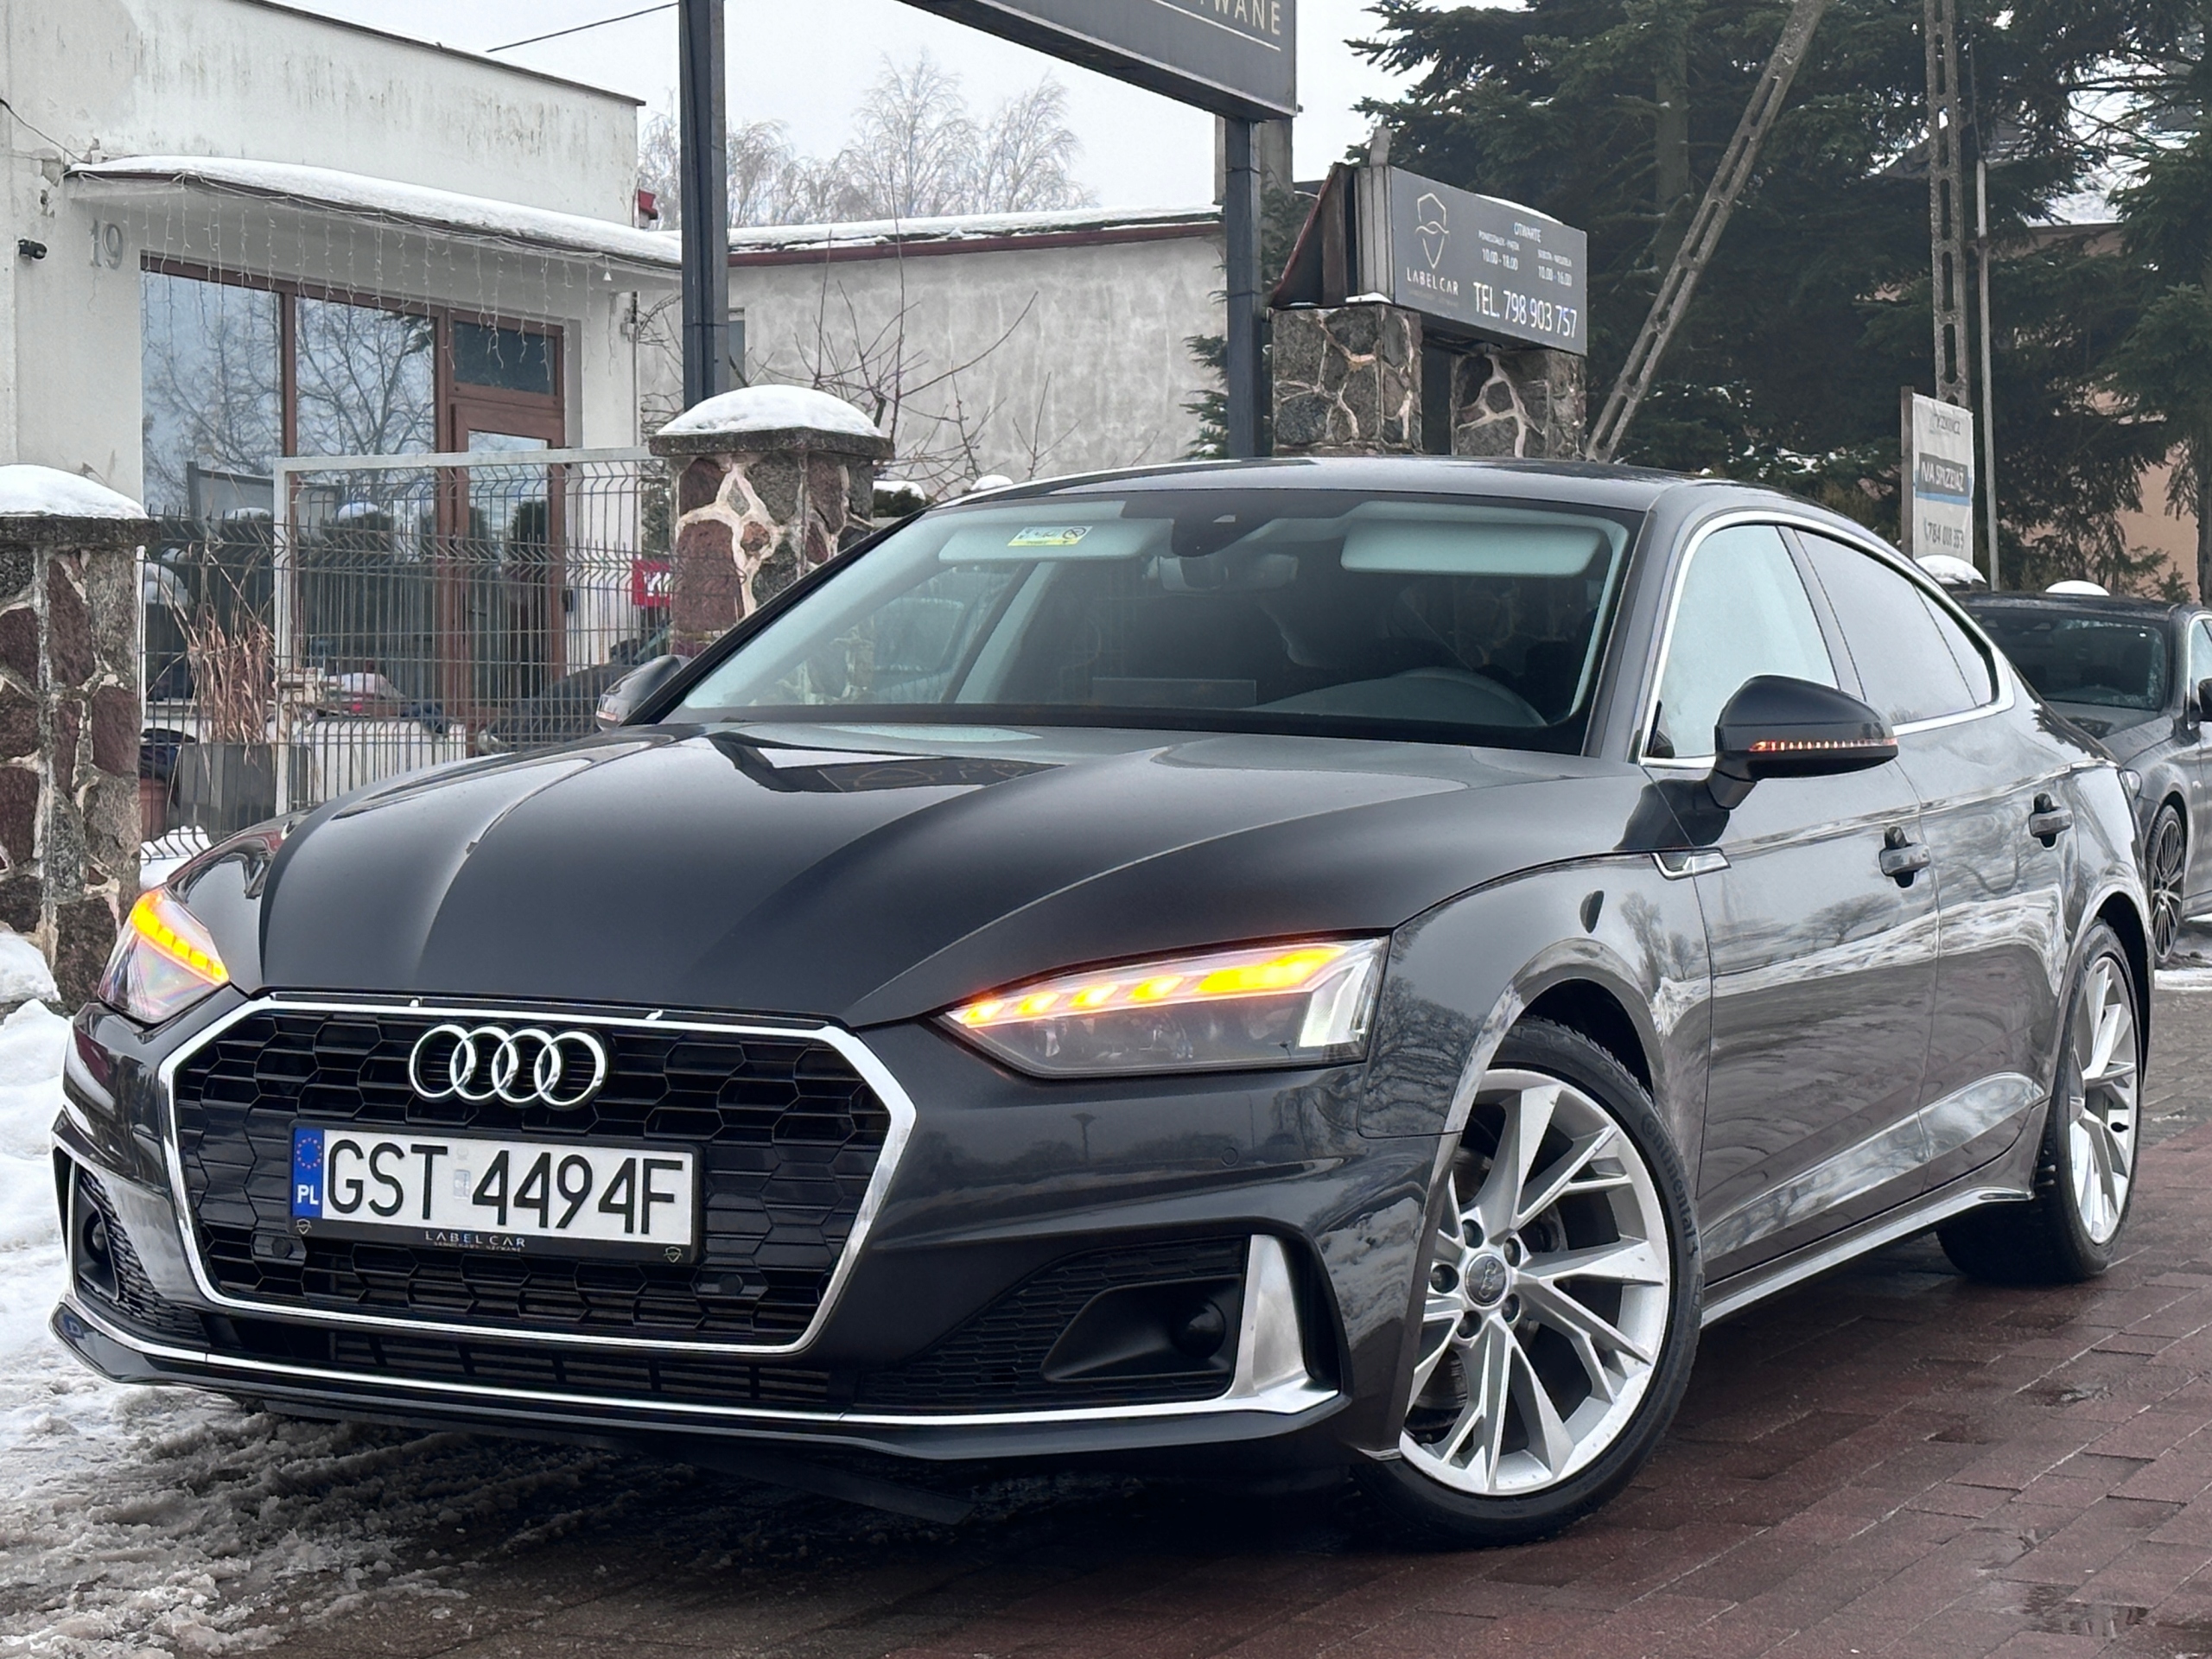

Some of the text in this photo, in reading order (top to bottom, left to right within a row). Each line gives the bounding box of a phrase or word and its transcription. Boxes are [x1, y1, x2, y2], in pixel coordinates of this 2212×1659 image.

[1200, 0, 1281, 35] ANE
[89, 218, 123, 270] 19
[1473, 282, 1500, 319] TEL.
[1503, 290, 1527, 325] 798
[1530, 298, 1552, 332] 903
[1555, 305, 1577, 338] 757
[1921, 461, 1935, 484] NA
[297, 1184, 319, 1205] PL
[327, 1139, 683, 1235] GST 4494F
